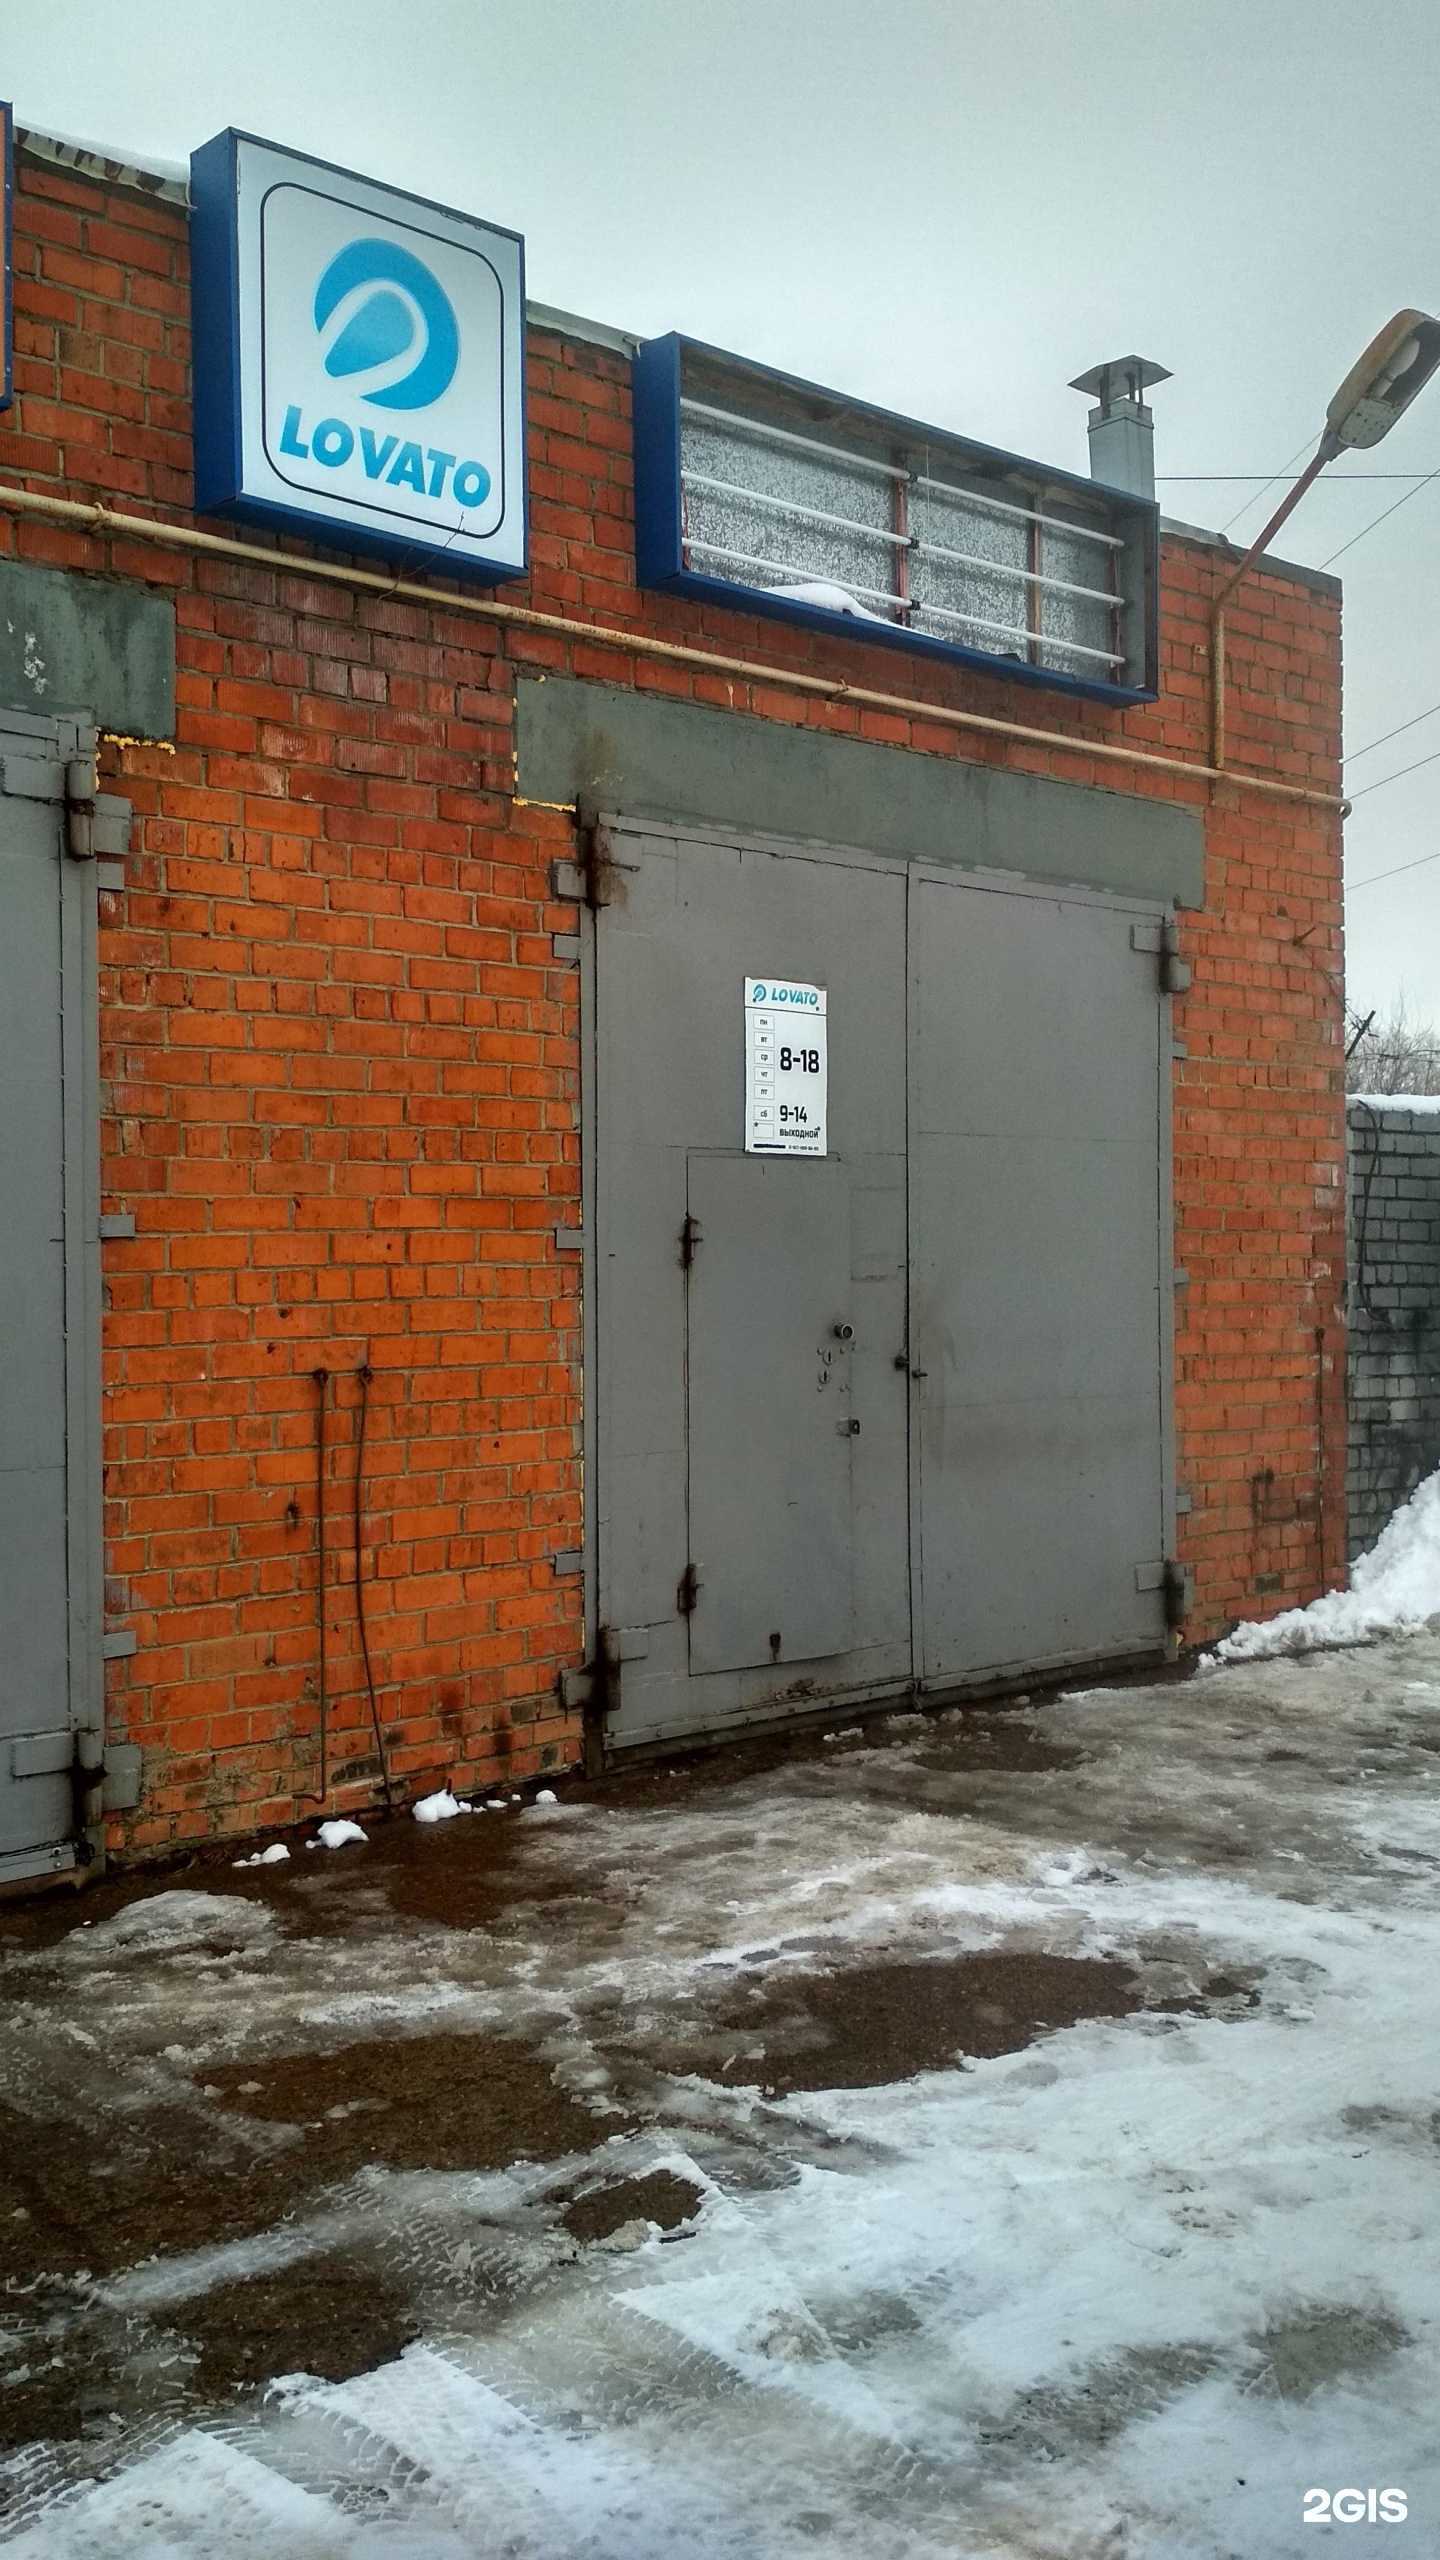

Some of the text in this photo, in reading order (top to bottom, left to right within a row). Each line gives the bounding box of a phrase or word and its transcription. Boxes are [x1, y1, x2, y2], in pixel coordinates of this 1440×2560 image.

[279, 404, 491, 508] LOVATO
[771, 987, 818, 1006] LOVATO
[780, 1047, 820, 1074] 8-18
[779, 1105, 808, 1123] 9-14
